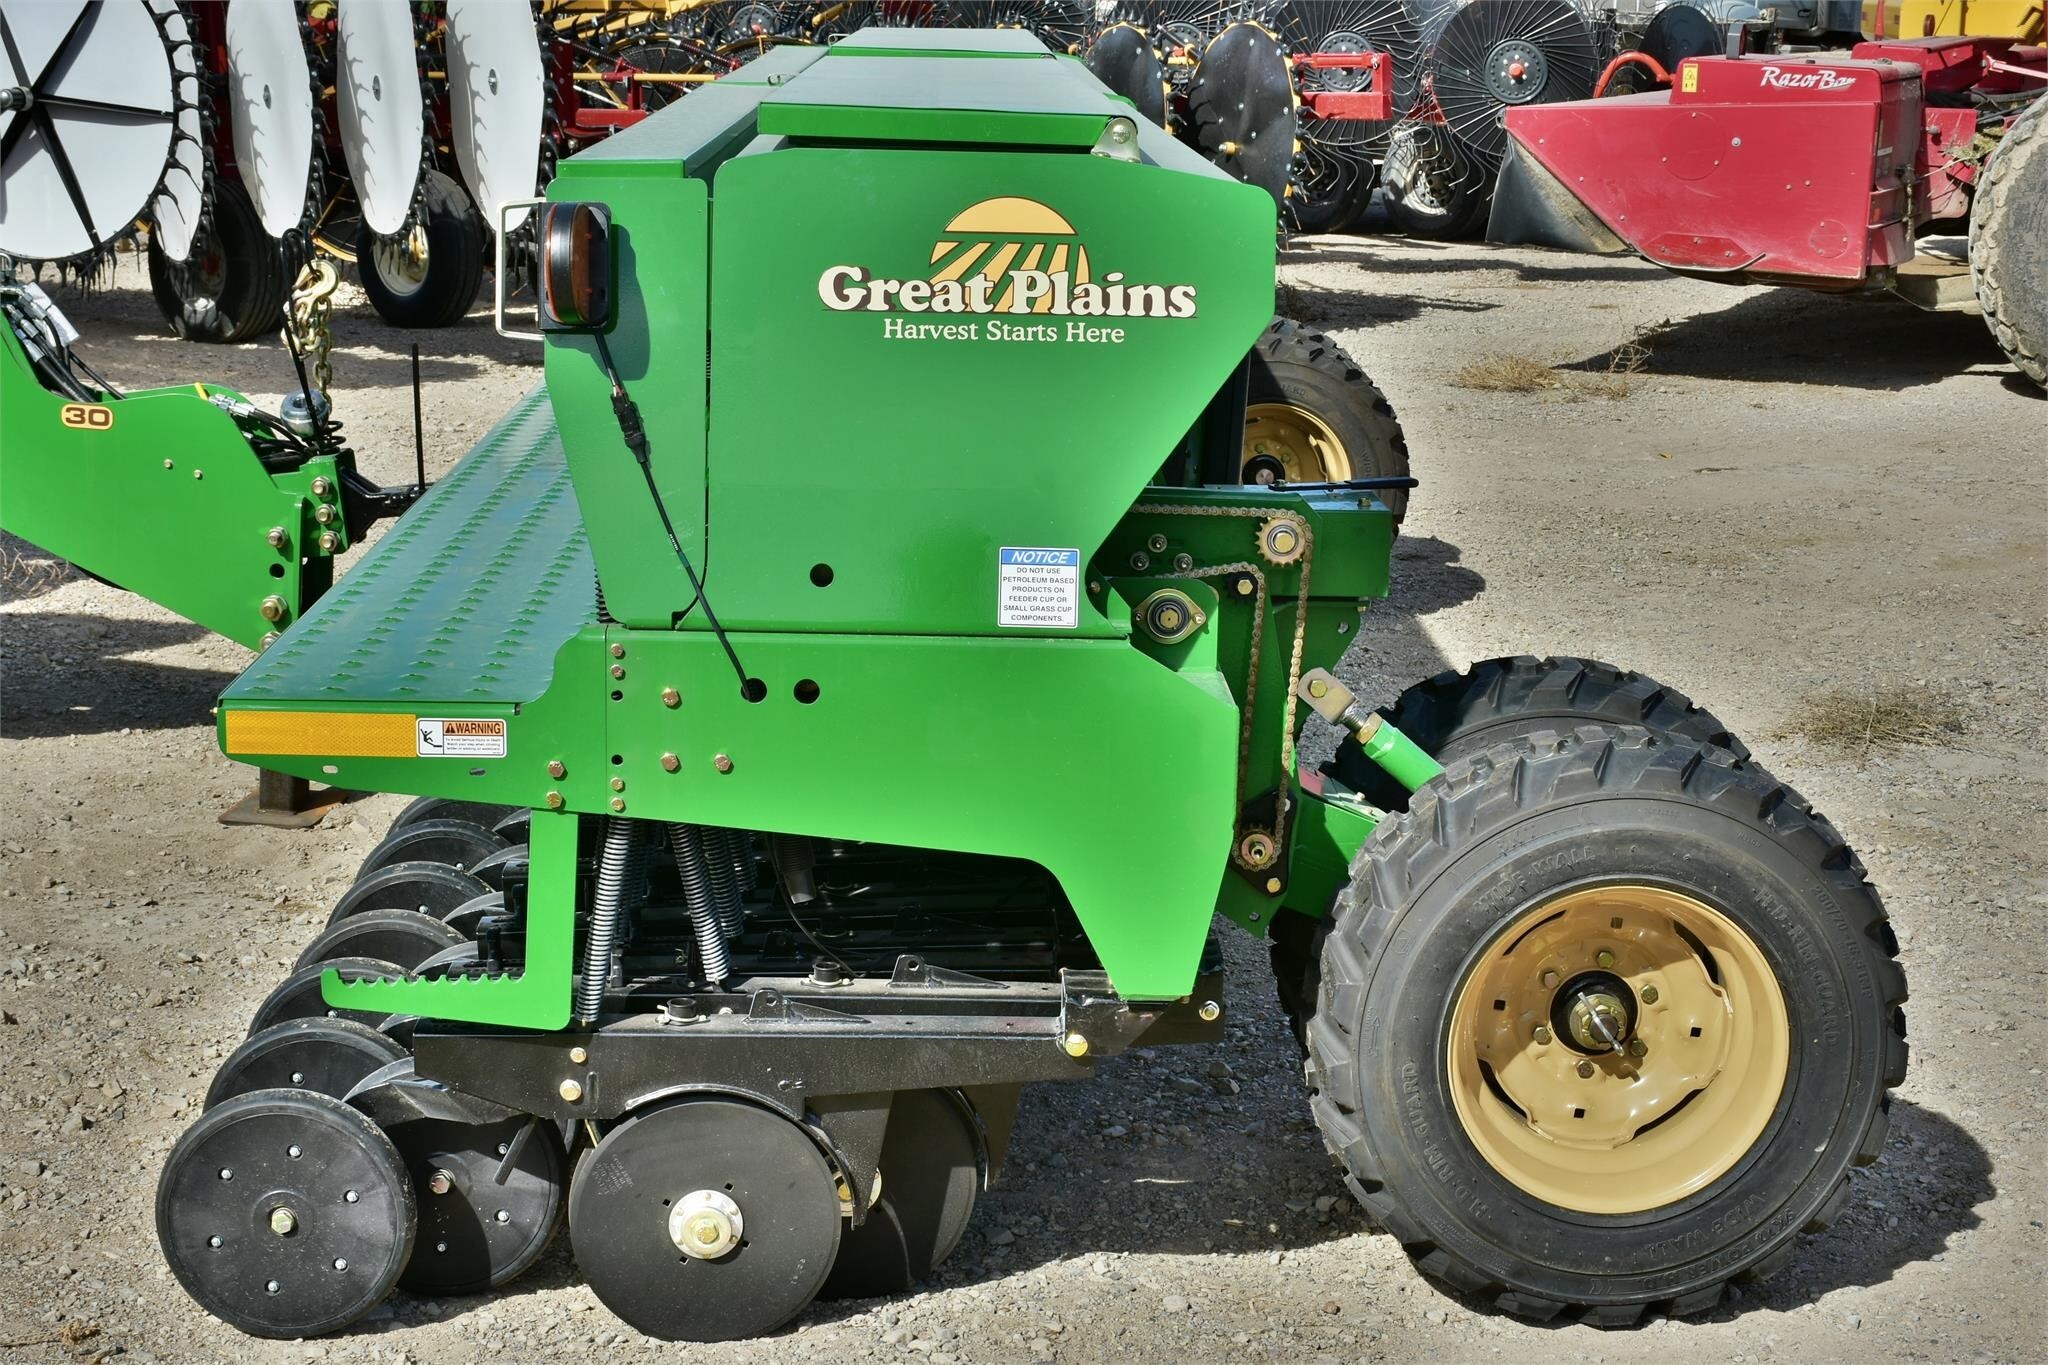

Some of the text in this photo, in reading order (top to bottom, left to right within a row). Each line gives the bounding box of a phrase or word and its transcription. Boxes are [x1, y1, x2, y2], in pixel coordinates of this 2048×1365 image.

[818, 265, 1199, 319] Great Plains
[883, 318, 1125, 343] Harvest Starts Here
[65, 406, 110, 427] 30
[1011, 550, 1071, 564] NOTICE
[1046, 567, 1061, 575] USE
[1002, 576, 1047, 584] PETROLEUM
[1012, 585, 1052, 593] PRODUCTS
[1003, 604, 1028, 612] SMALL
[455, 722, 501, 734] WARNING
